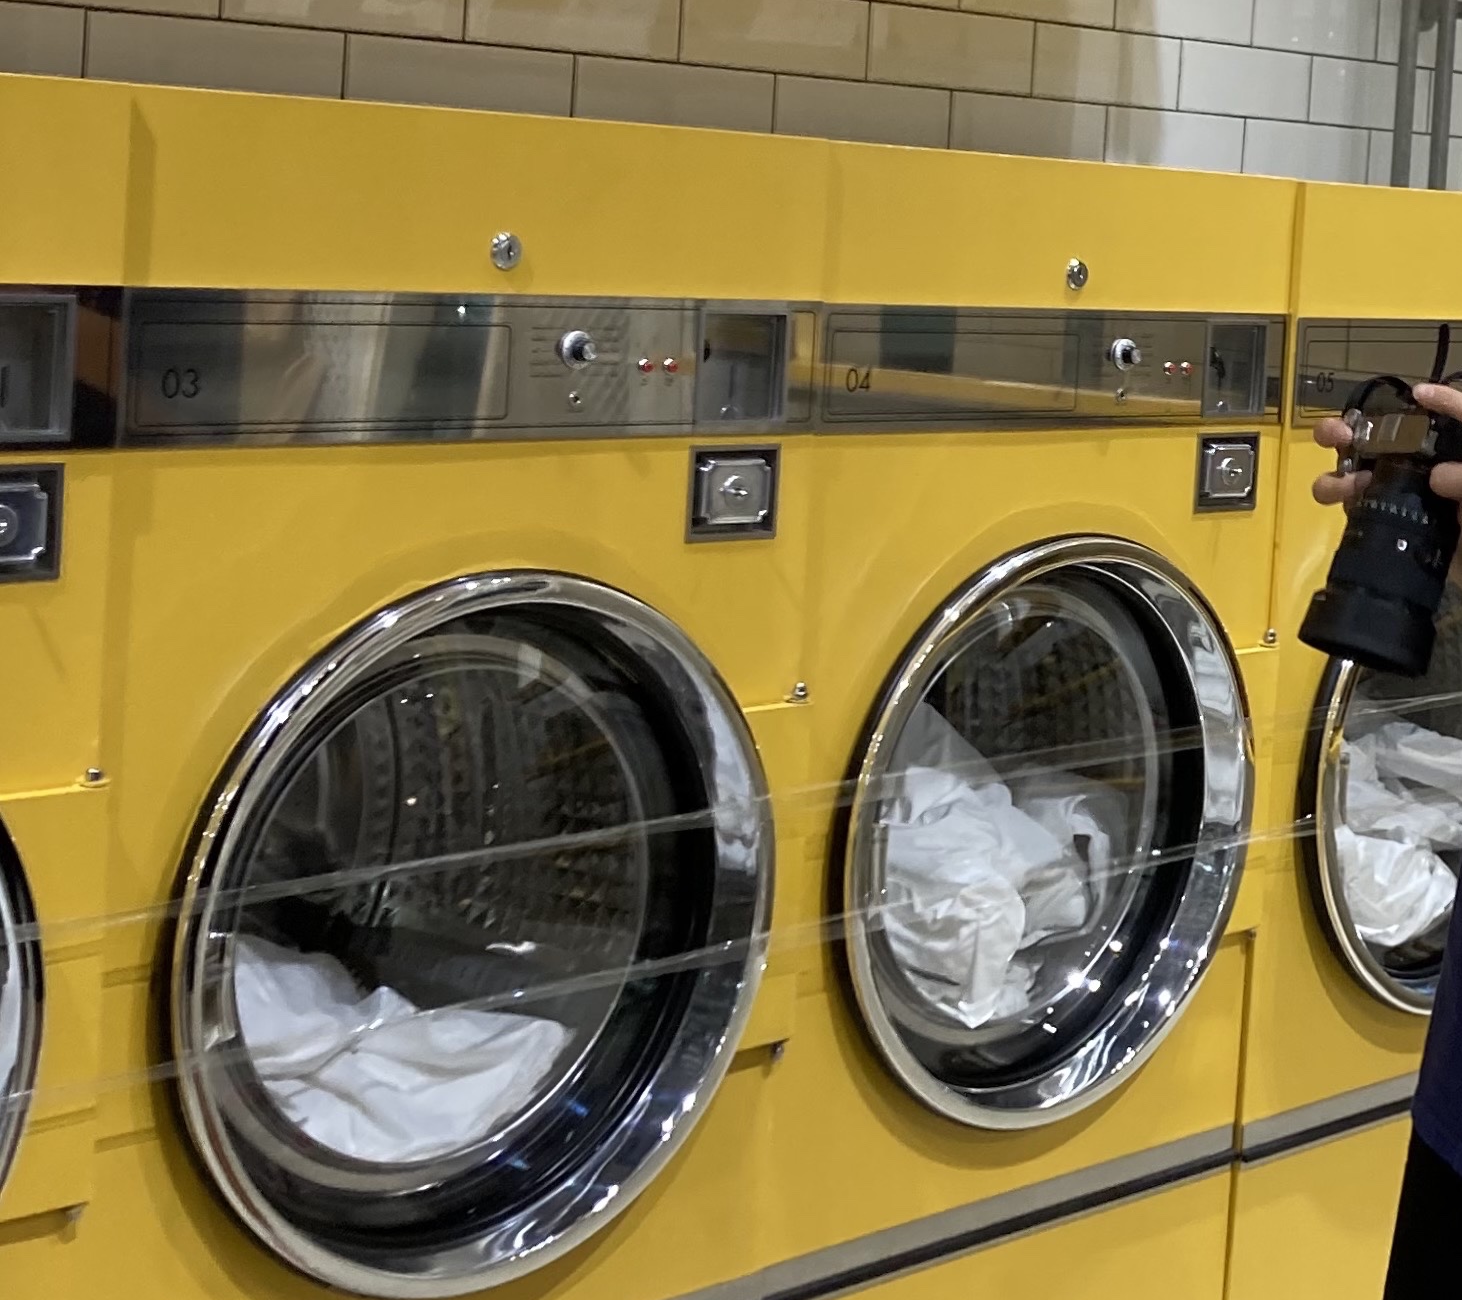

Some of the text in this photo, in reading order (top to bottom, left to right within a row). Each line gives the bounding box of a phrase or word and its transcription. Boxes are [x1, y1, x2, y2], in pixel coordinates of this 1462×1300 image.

[161, 368, 200, 399] 03
[845, 367, 871, 393] 04
[1316, 371, 1335, 393] 05
